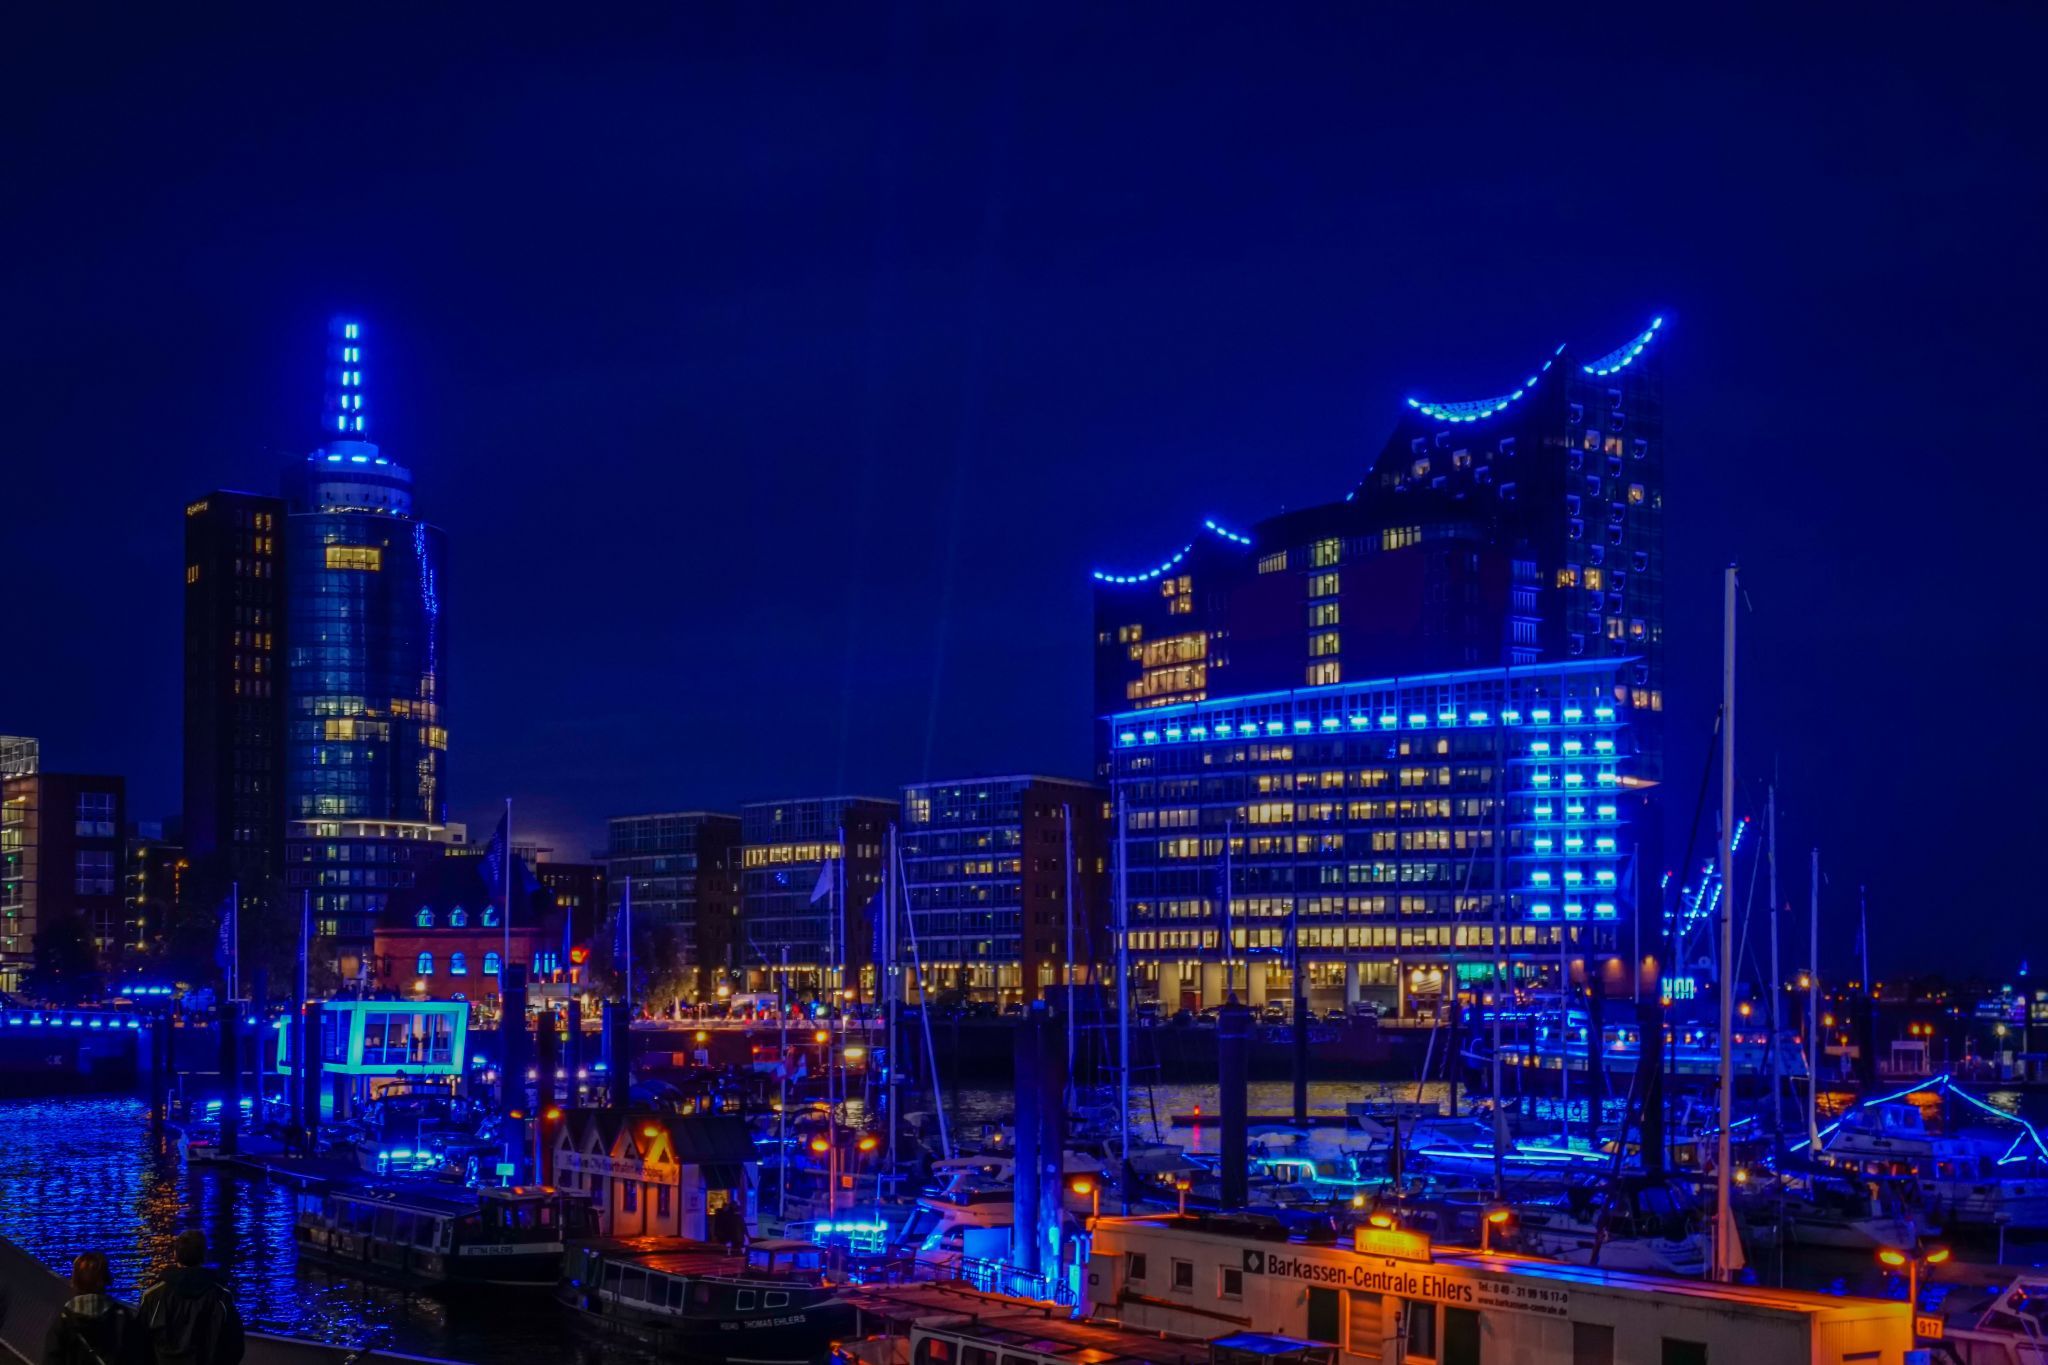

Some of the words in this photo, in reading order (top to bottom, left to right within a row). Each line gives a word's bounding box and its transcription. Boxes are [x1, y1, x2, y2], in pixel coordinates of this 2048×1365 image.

[1268, 1254, 1417, 1294] Barkassen-Centrale
[1423, 1275, 1473, 1302] Ehlers
[744, 1318, 772, 1329] THOMAS
[774, 1315, 806, 1327] EHLERS
[1919, 1320, 1939, 1336] 917
